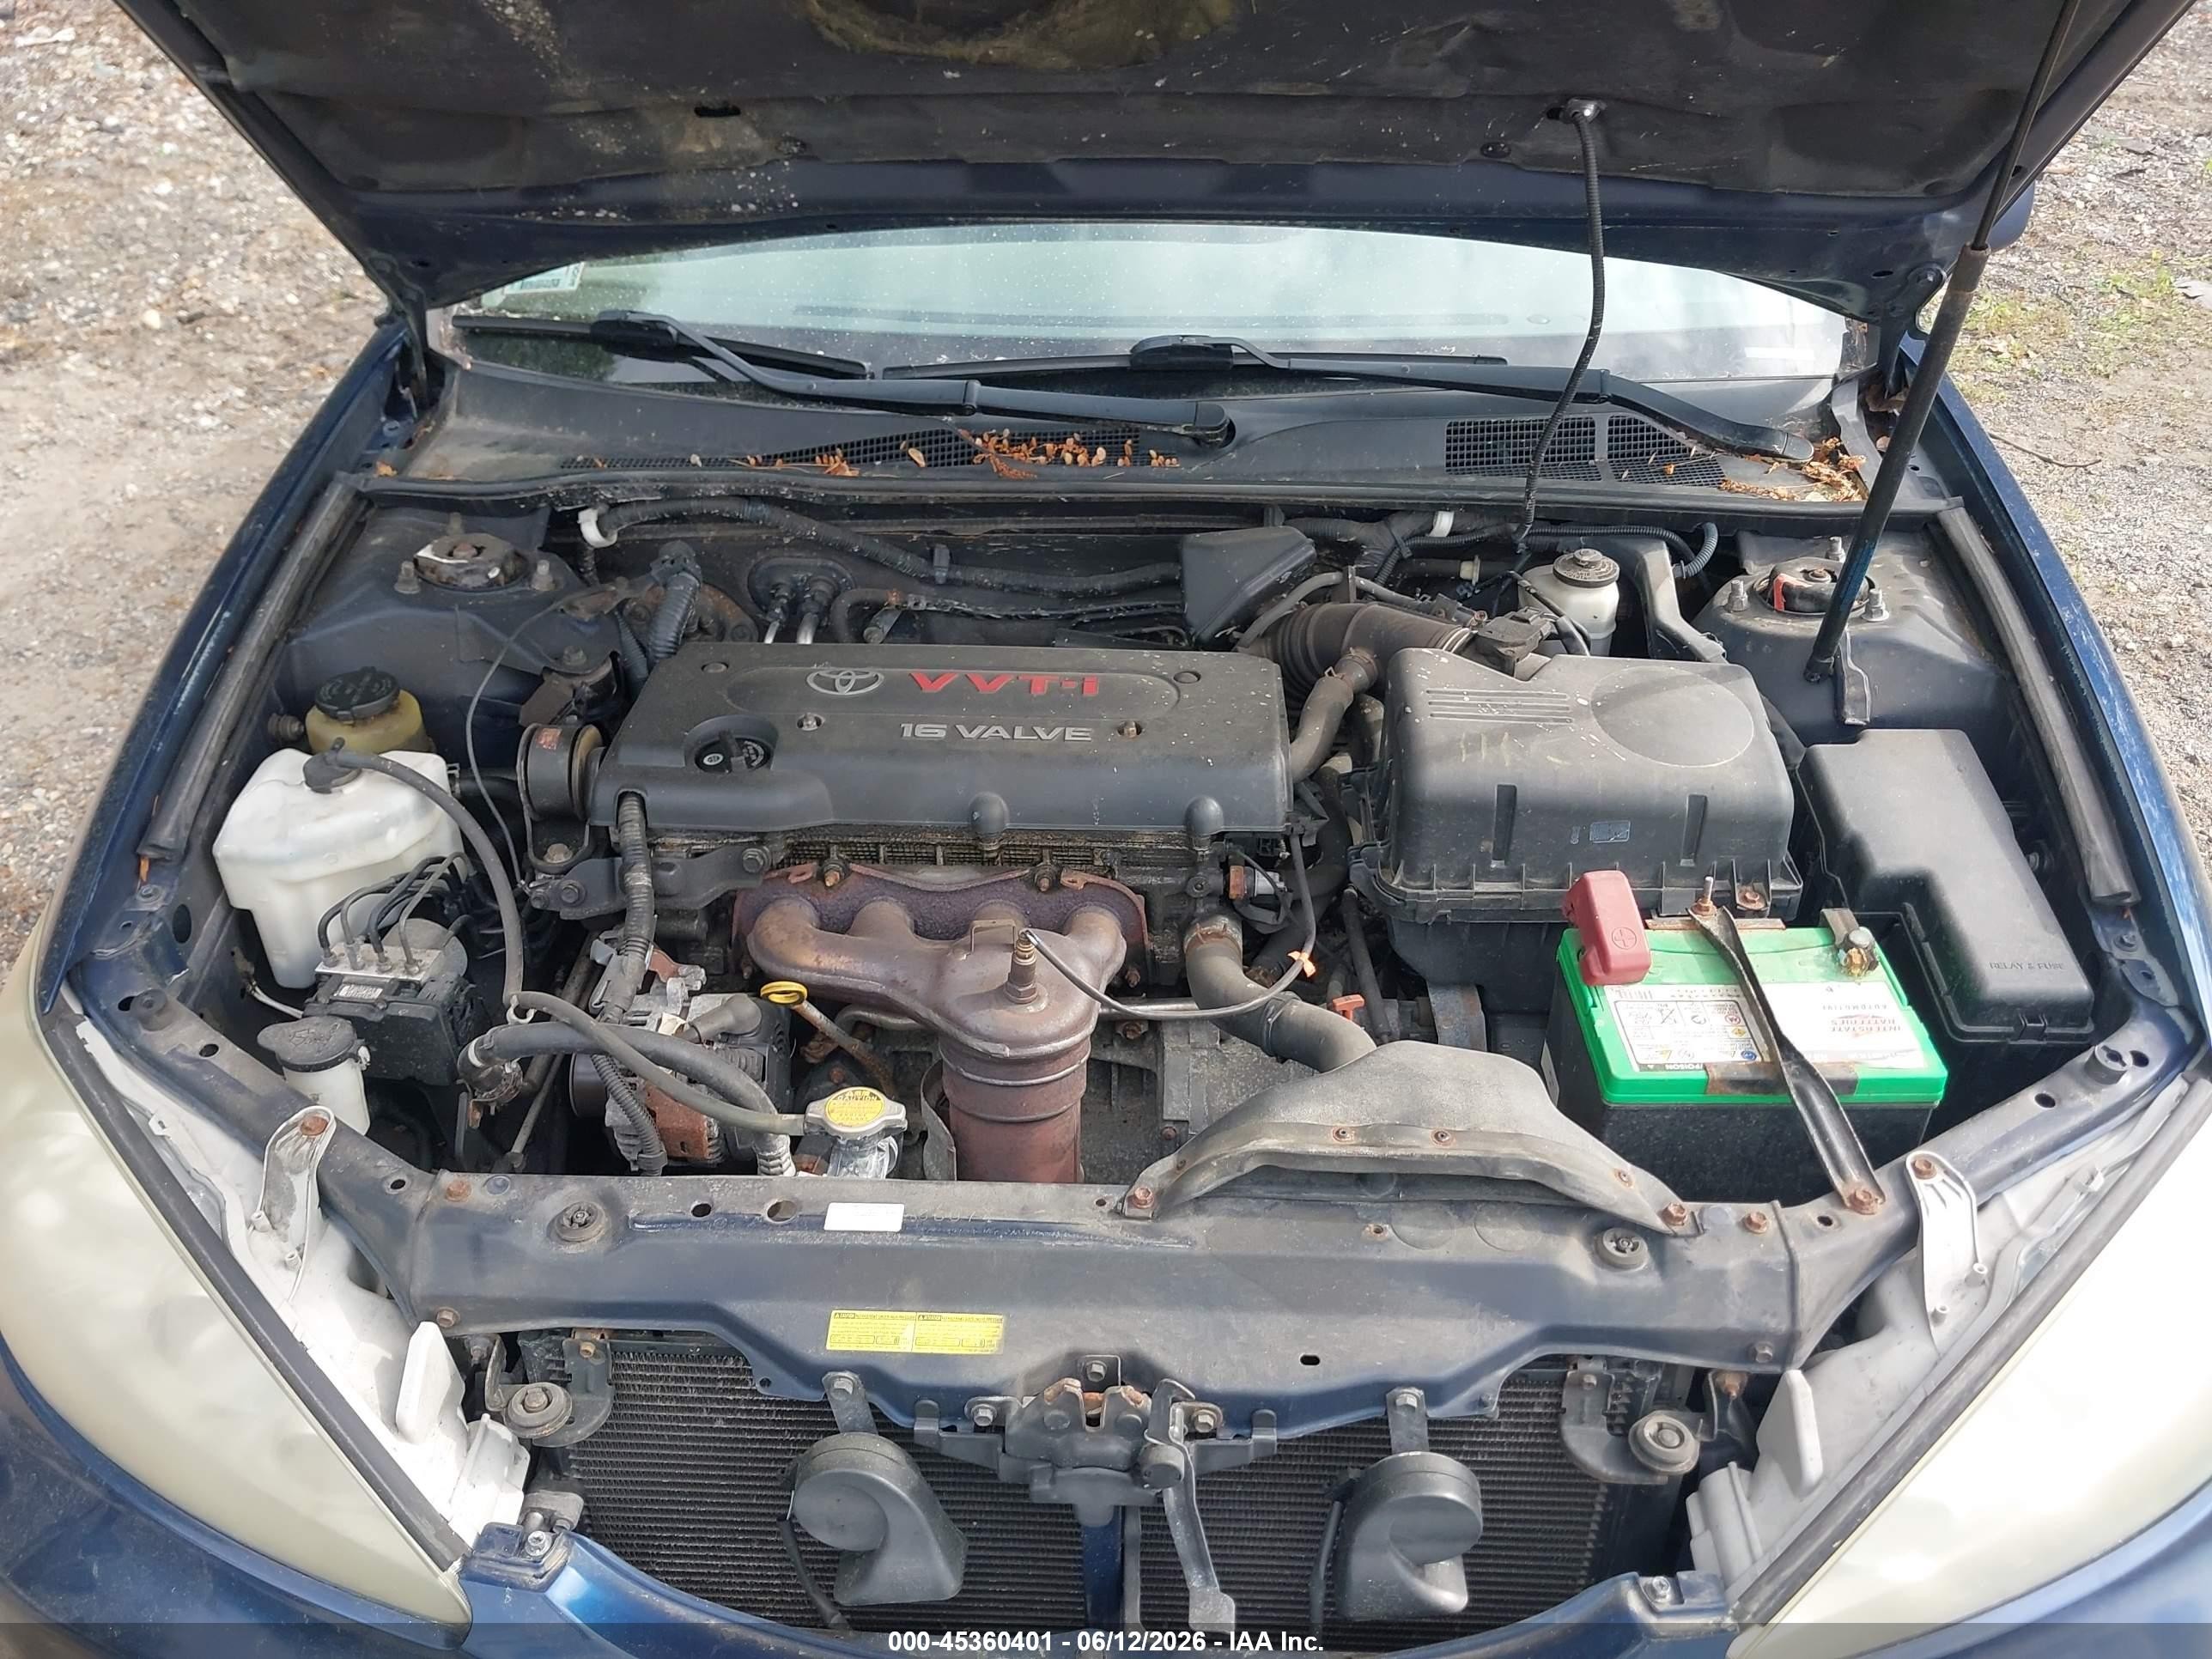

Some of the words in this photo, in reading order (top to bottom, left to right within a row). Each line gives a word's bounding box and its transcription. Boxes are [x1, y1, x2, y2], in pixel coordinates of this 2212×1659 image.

[900, 723, 947, 739] 16
[956, 725, 1093, 742] VALVE
[1989, 961, 2024, 969] RELAY
